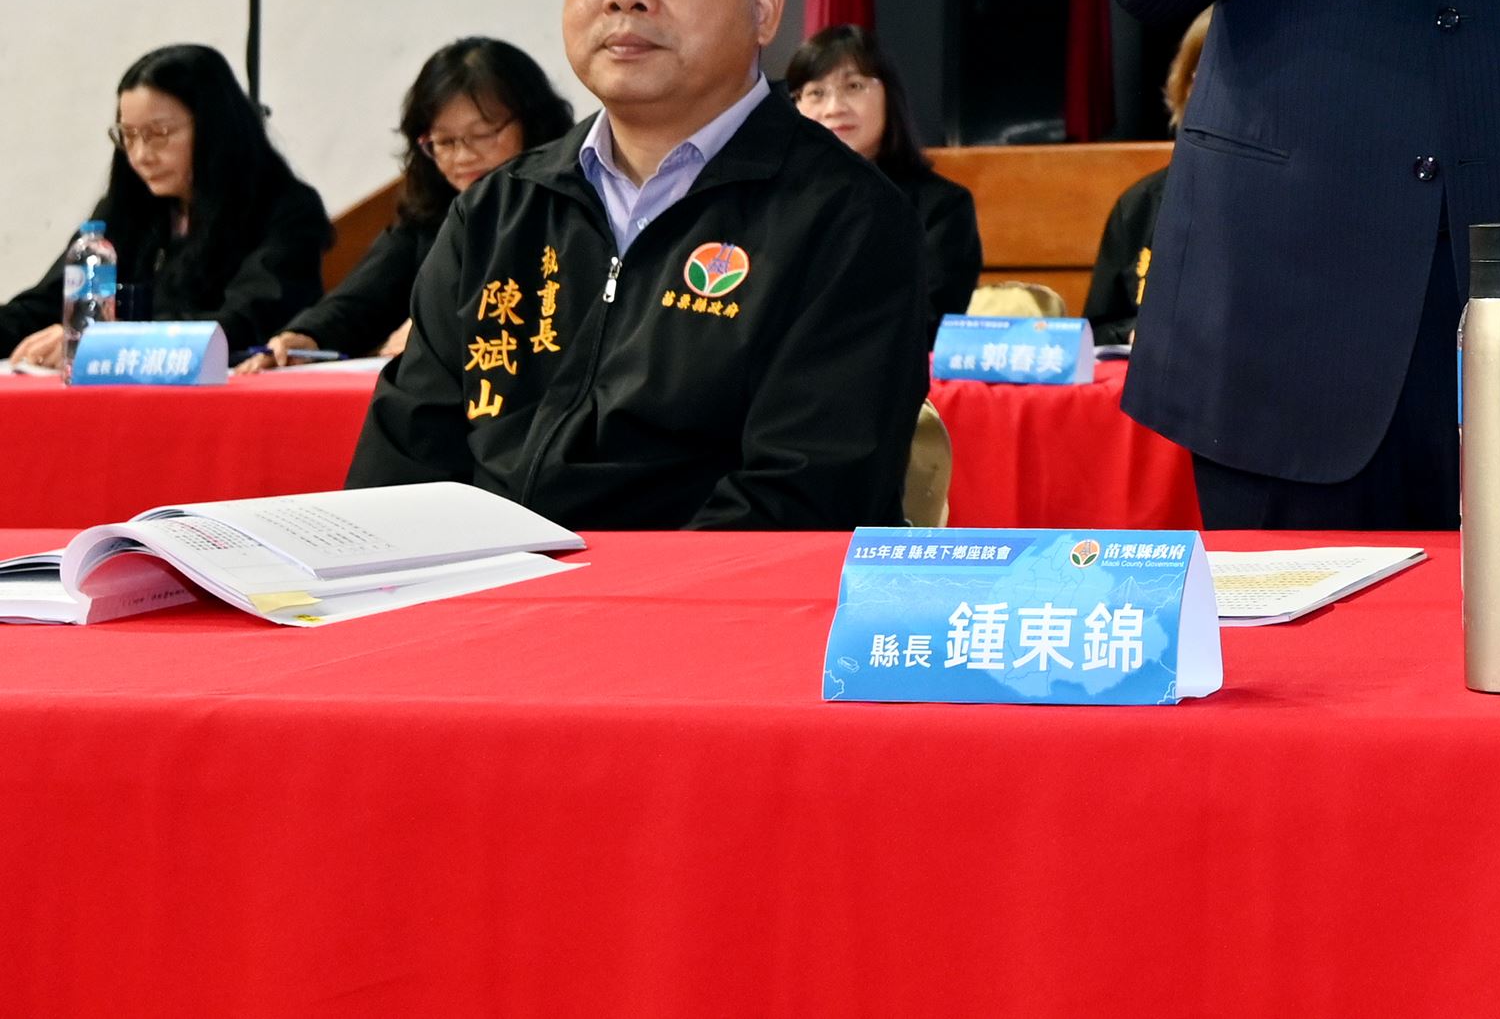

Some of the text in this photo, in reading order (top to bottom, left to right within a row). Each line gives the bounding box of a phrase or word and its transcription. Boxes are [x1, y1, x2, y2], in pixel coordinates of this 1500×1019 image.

[464, 278, 525, 420] 陳斌山
[981, 343, 1065, 373] 郭春美
[853, 545, 1011, 561] 115年度 縣長下鄉座談會
[1104, 542, 1185, 559] 苗栗縣政府
[1121, 559, 1144, 569] County
[1145, 559, 1185, 568] Government
[870, 601, 1144, 673] 縣長 鍾東錦
